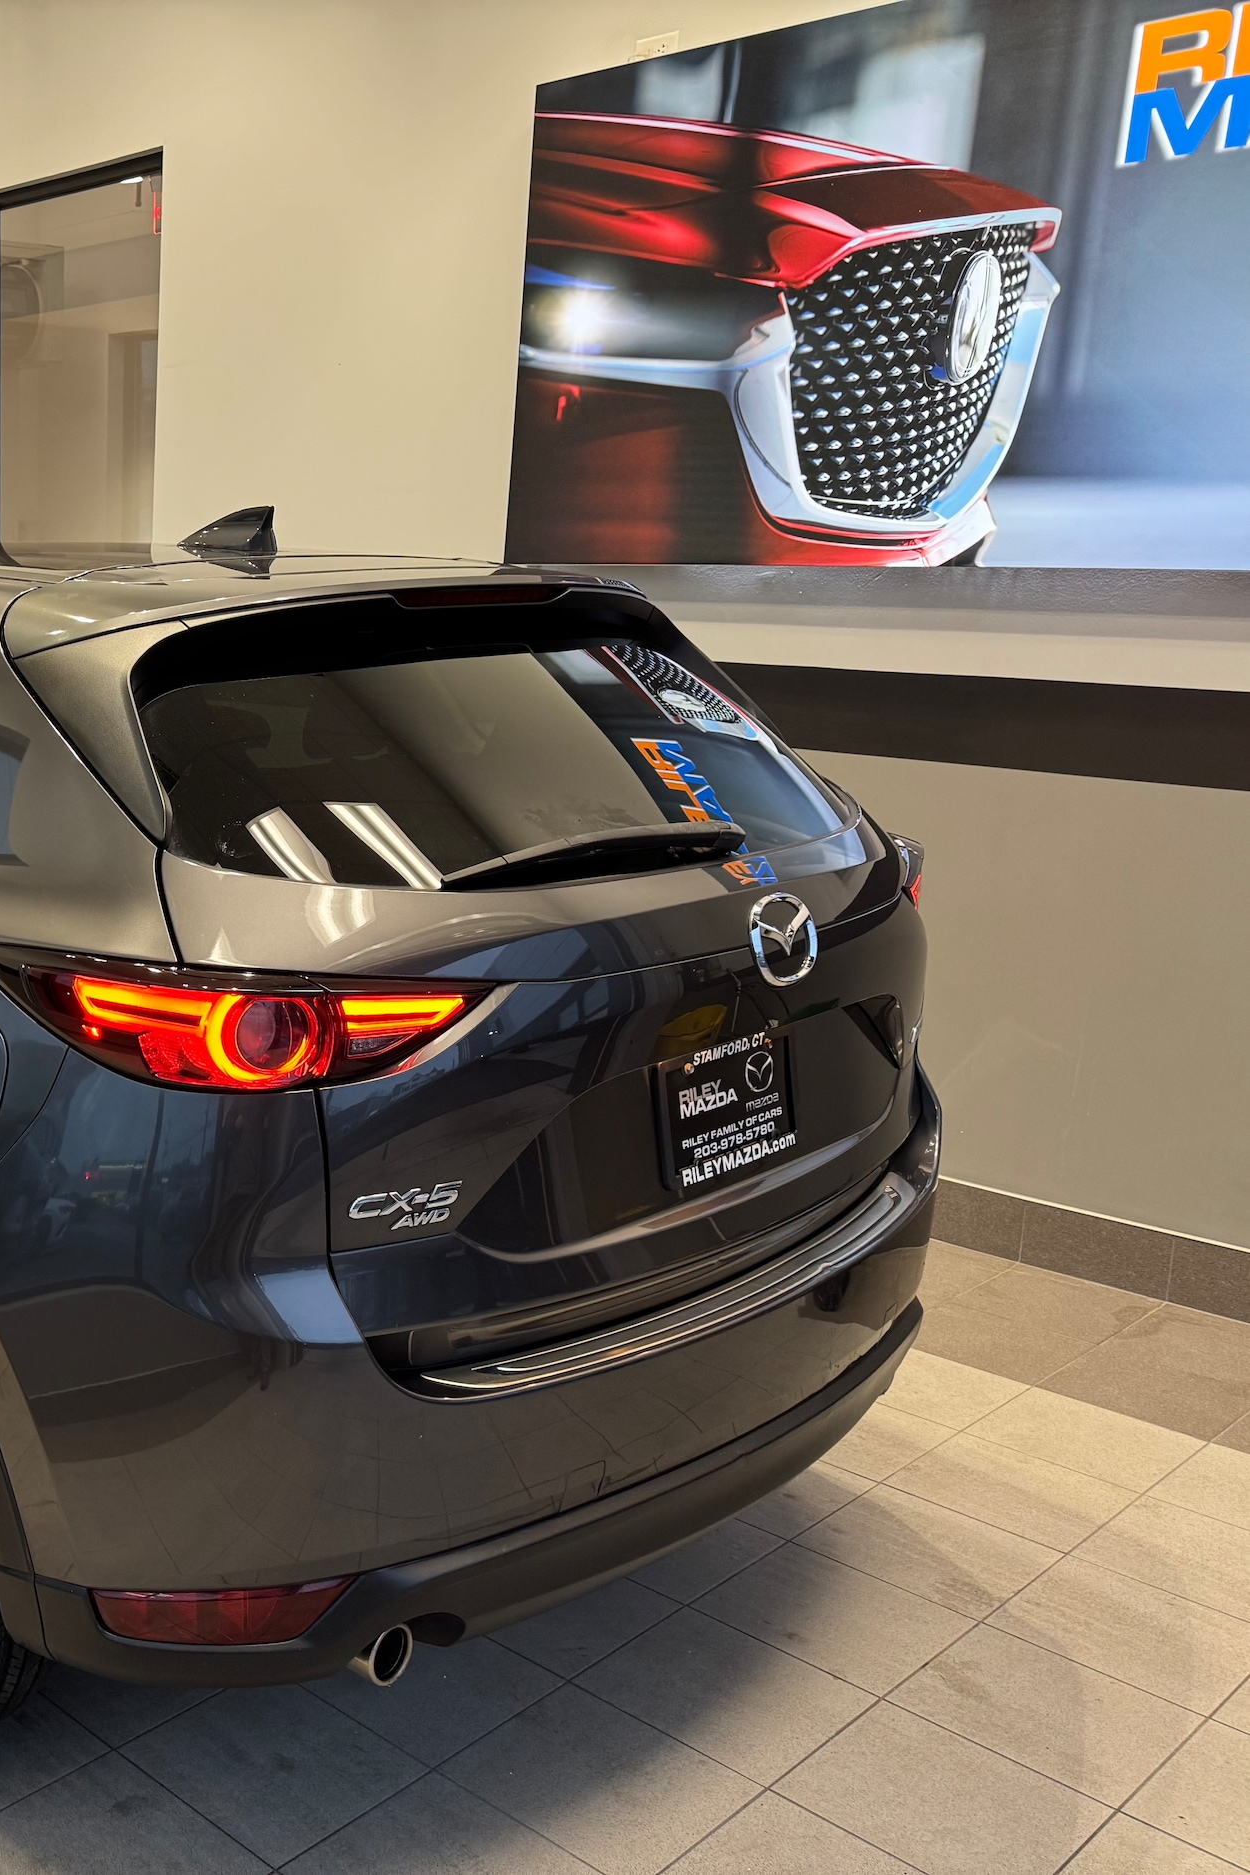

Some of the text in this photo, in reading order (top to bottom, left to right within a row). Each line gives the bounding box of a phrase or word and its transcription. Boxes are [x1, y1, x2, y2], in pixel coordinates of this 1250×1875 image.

[693, 1032, 765, 1067] STAMFORD, CT
[678, 1078, 722, 1104] RILEY
[679, 1087, 739, 1120] MAZDA
[745, 1091, 780, 1112] mazda
[681, 1106, 783, 1150] RILEY FAMILY OF CARS
[681, 1132, 796, 1187] RILEYMAZDA.com
[348, 1180, 463, 1220] CX-5
[391, 1207, 451, 1231] AWD
